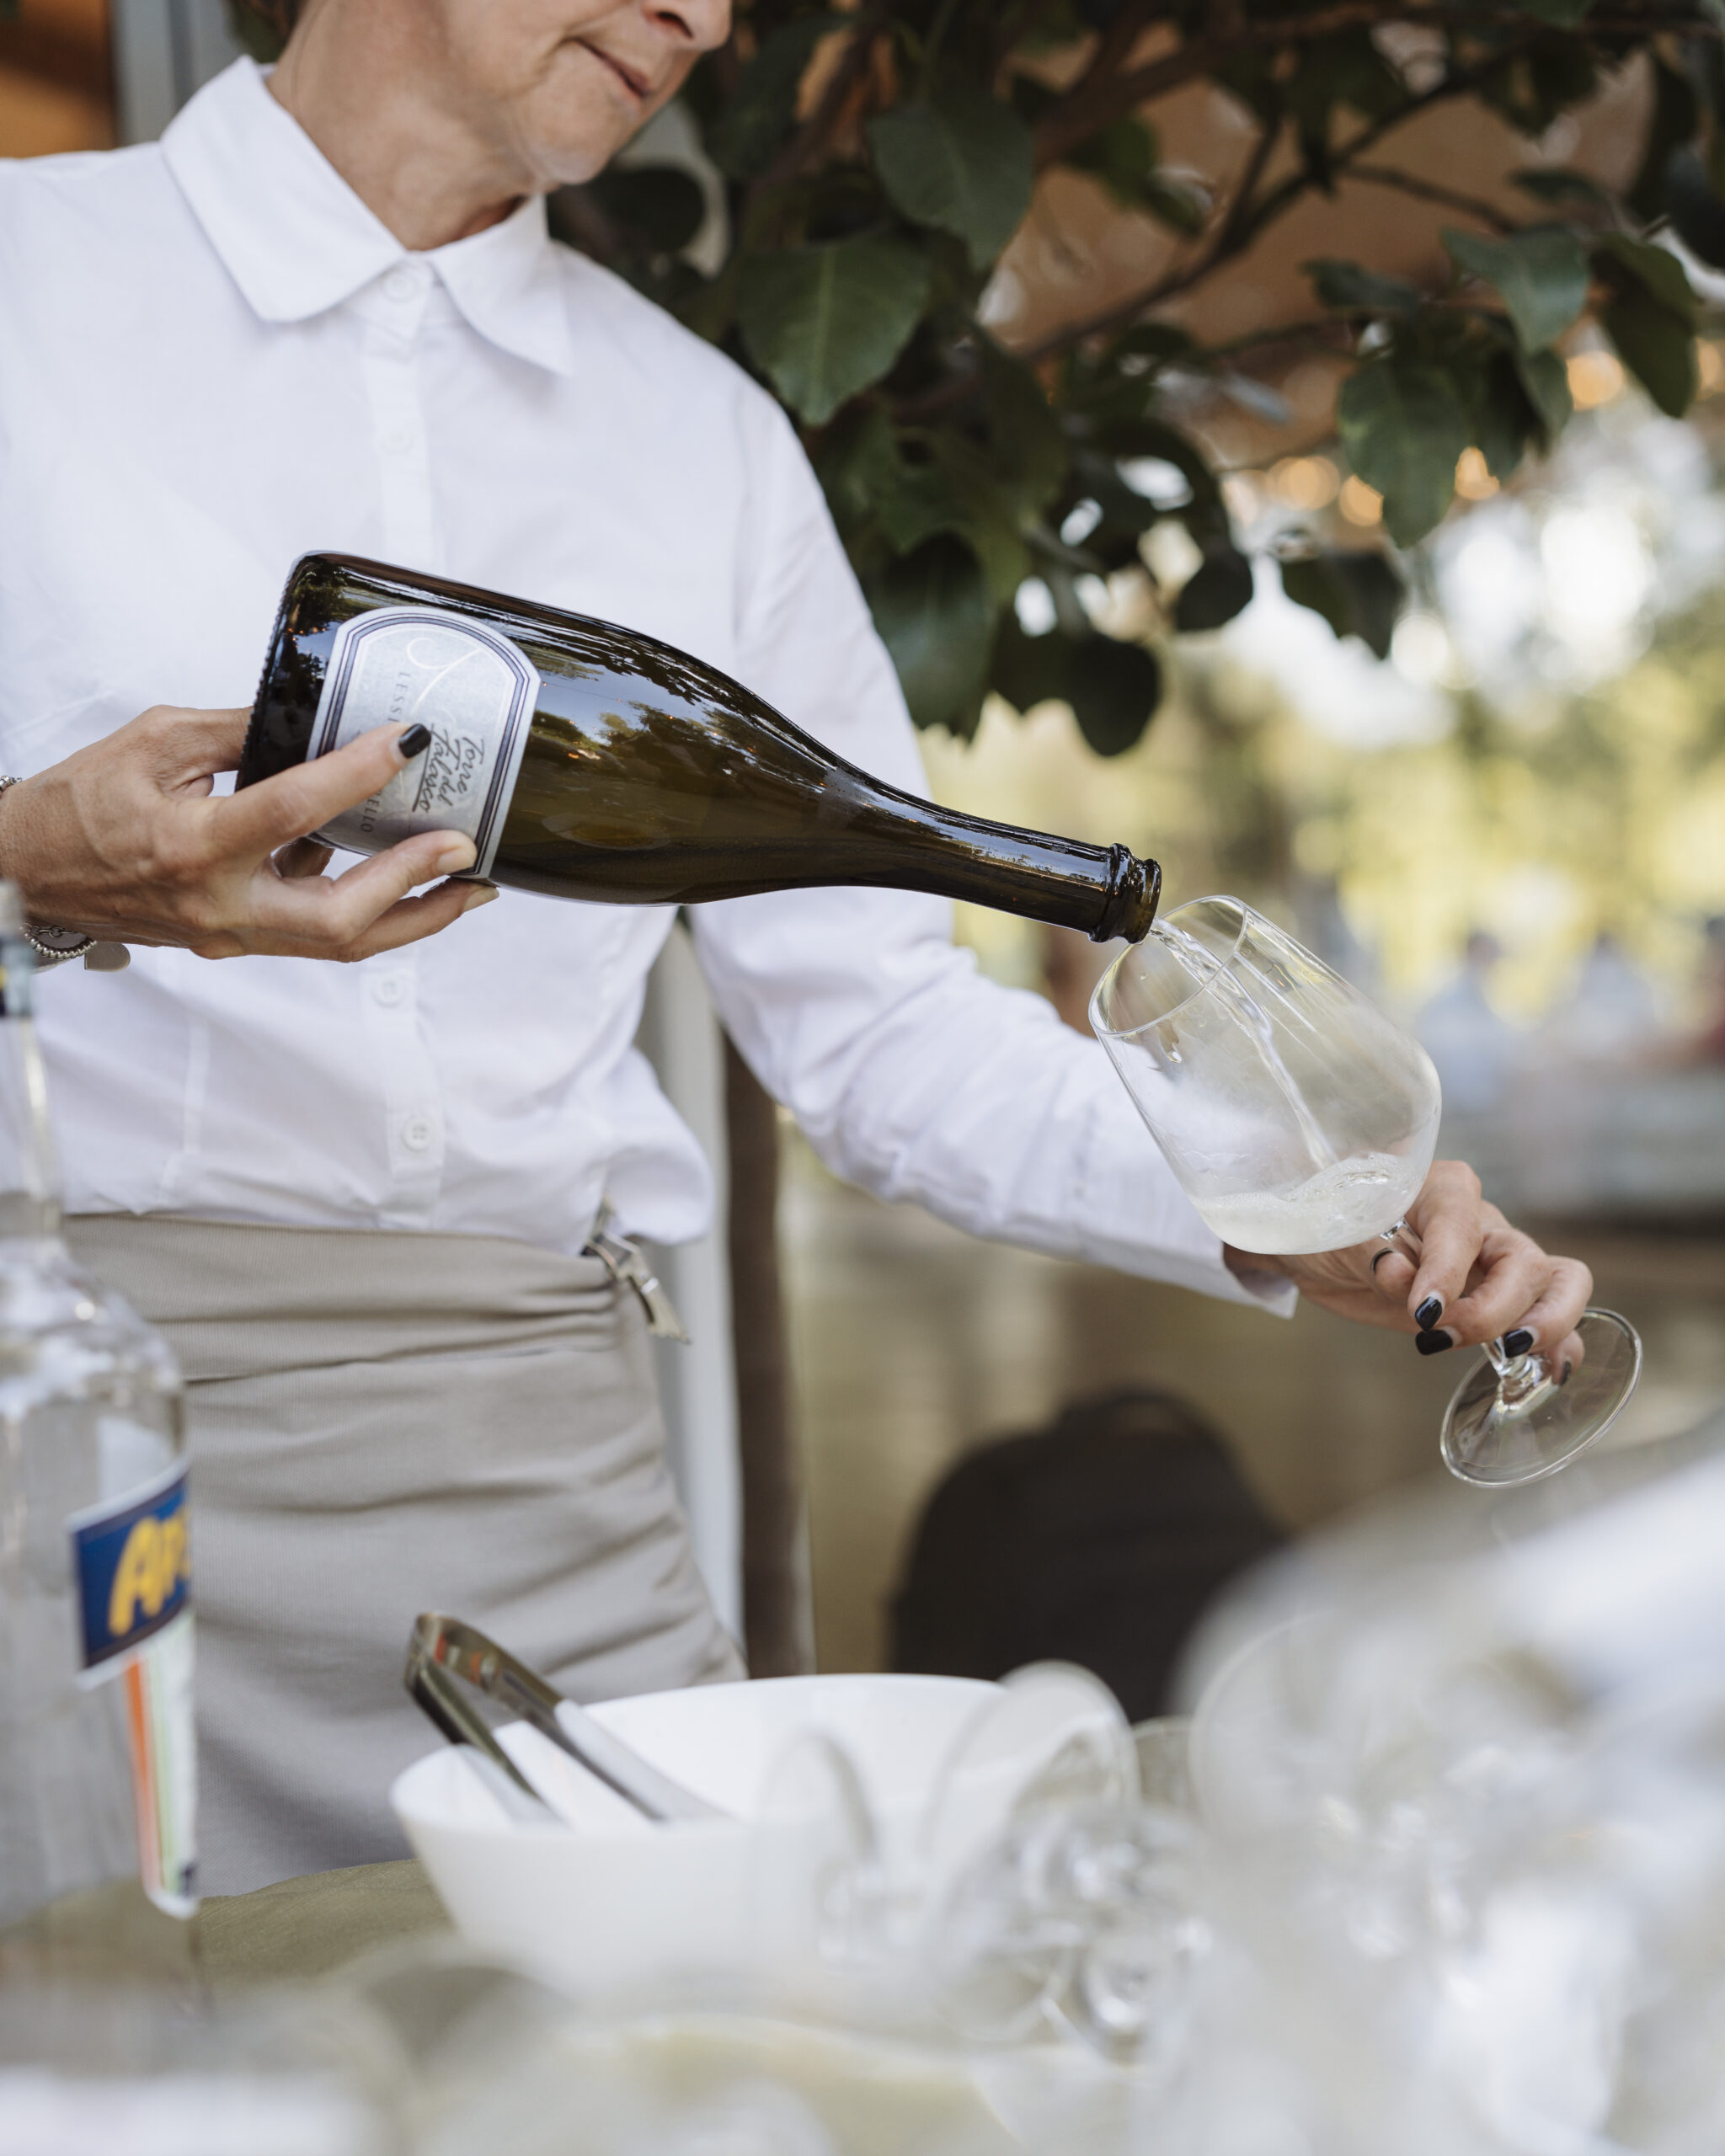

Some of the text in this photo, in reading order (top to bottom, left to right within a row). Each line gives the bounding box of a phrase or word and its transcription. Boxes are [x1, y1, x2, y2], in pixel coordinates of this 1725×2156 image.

[360, 671, 411, 833] LESSI ELLO
[419, 728, 461, 814] Falasco
[436, 776, 456, 807] del
[457, 736, 484, 794] Torre
[108, 1505, 192, 1636] AP
